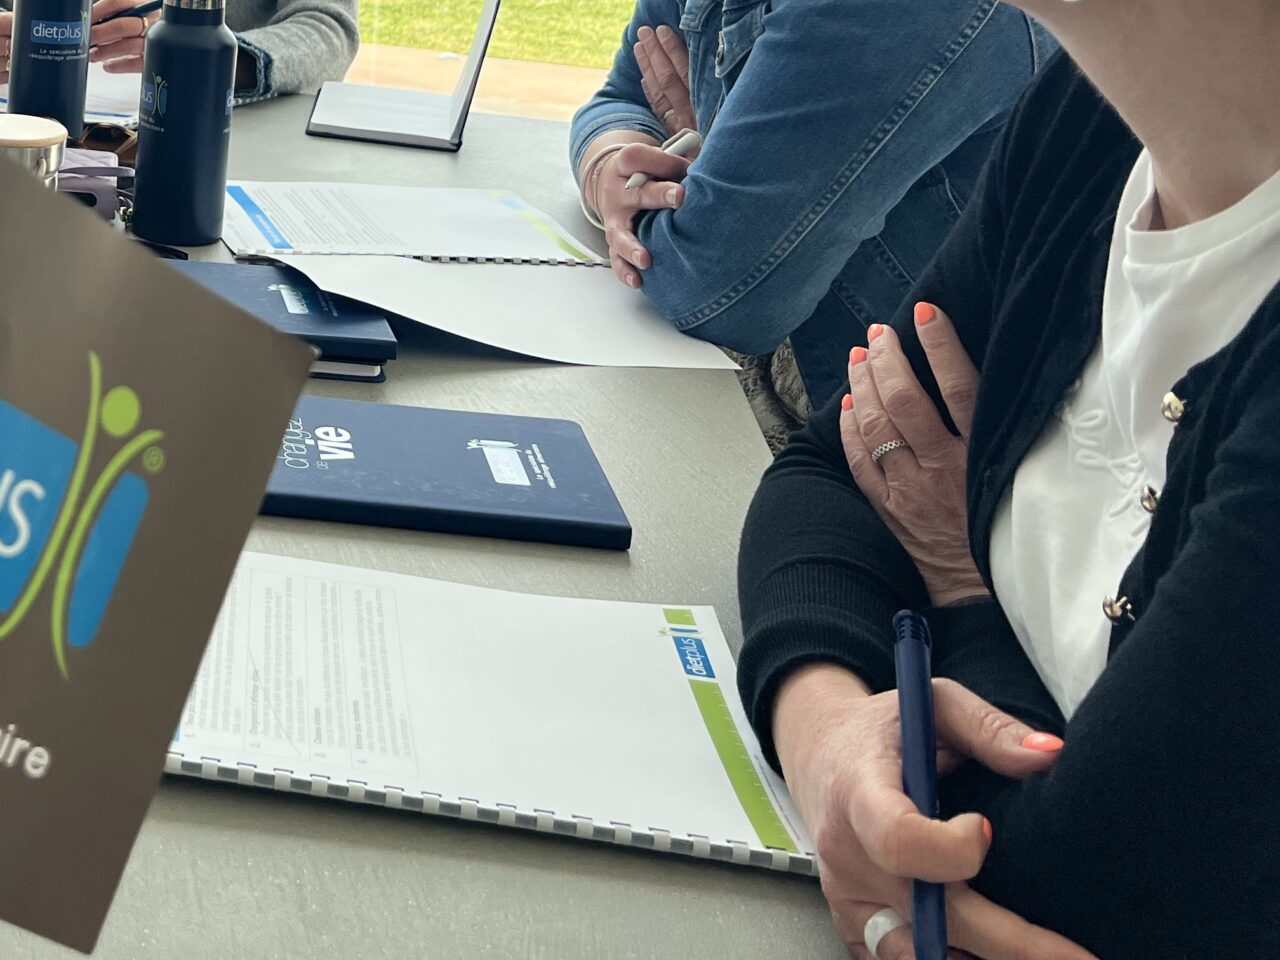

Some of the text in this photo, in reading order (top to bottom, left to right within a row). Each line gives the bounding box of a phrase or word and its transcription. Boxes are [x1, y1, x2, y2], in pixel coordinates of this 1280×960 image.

[33, 23, 81, 42] dietplus
[305, 426, 355, 460] vie
[679, 637, 707, 675] dietplus
